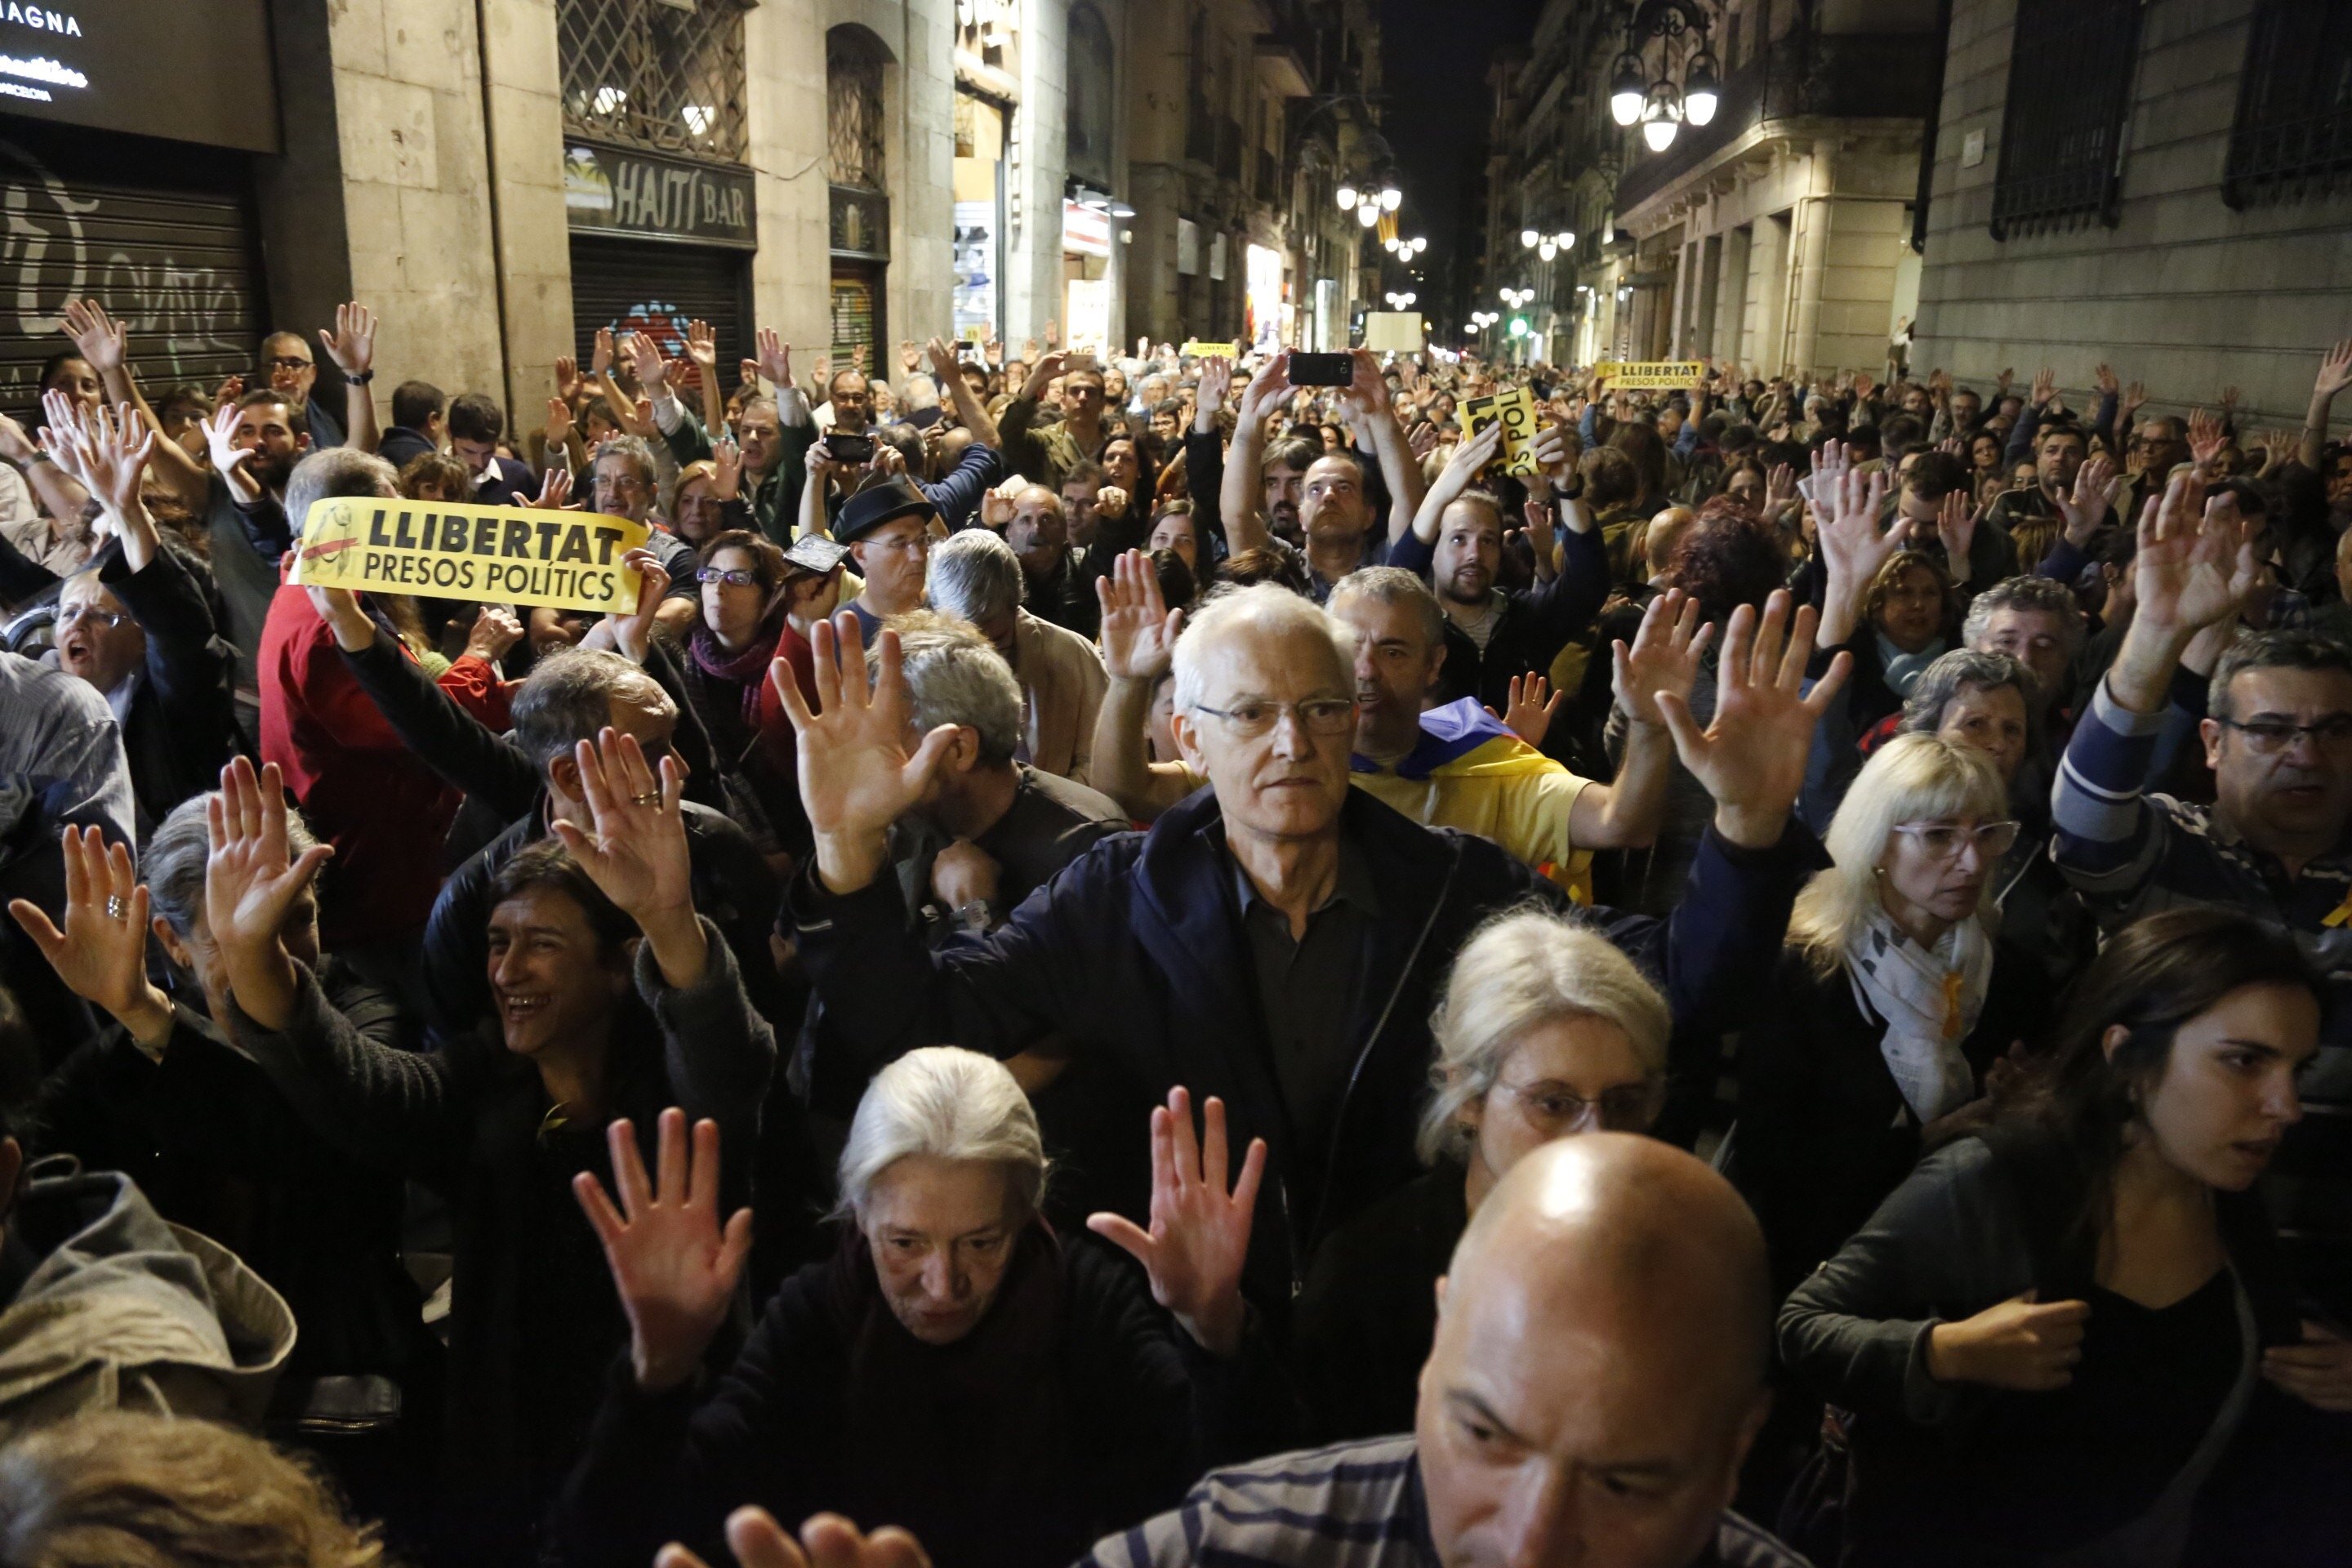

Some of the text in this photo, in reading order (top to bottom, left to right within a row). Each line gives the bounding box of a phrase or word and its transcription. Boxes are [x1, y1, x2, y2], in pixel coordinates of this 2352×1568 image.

[0, 1, 82, 37] AGNA
[0, 82, 52, 102] ARCELONA
[702, 183, 746, 227] BAR
[1619, 376, 1695, 386] PRESOS POLÍTIC
[1621, 365, 1699, 376] LLIBERTAT
[368, 510, 625, 566] LLIBERTAT
[364, 552, 615, 602] PRESOS POLÍTICS
